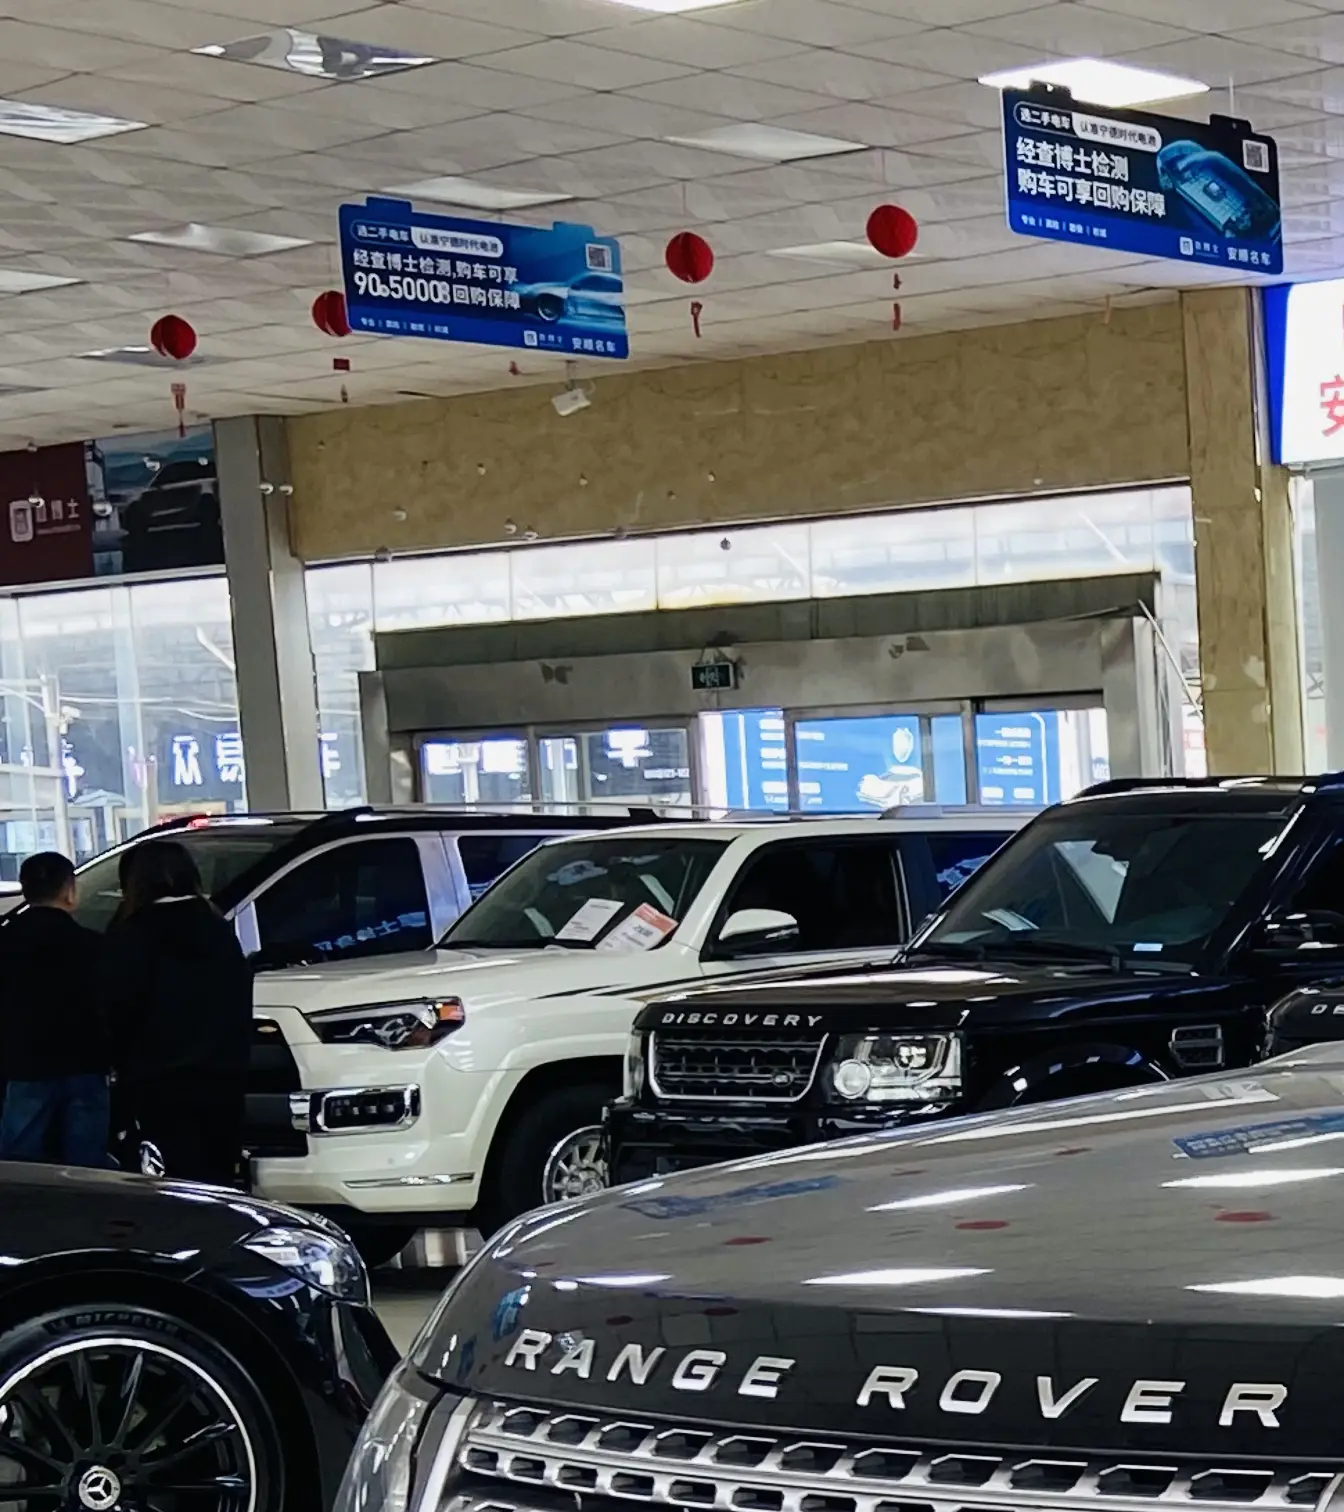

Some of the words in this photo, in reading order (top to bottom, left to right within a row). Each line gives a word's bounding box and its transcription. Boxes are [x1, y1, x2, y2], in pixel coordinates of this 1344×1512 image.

[1015, 136, 1129, 182] 经查博士检测
[1017, 168, 1167, 218] 购车可享回购保障
[662, 1012, 823, 1027] DISCOVERY
[504, 1327, 796, 1399] RANGE
[856, 1364, 1288, 1428] ROVER
